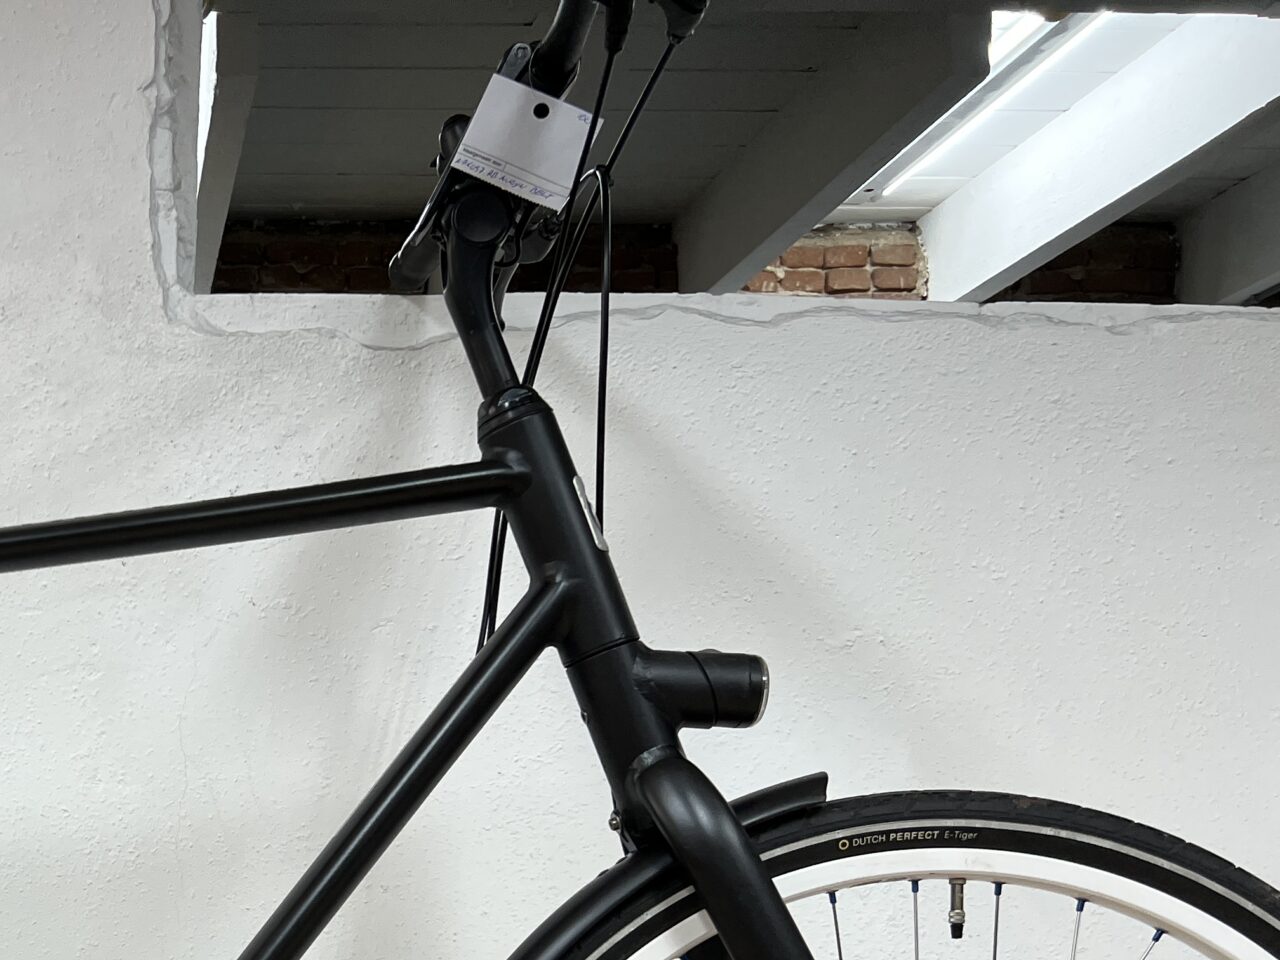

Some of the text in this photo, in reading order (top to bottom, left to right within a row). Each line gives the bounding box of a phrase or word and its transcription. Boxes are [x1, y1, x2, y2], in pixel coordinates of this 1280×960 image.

[852, 830, 978, 847] DUTCH PERFECT E-Tiger
